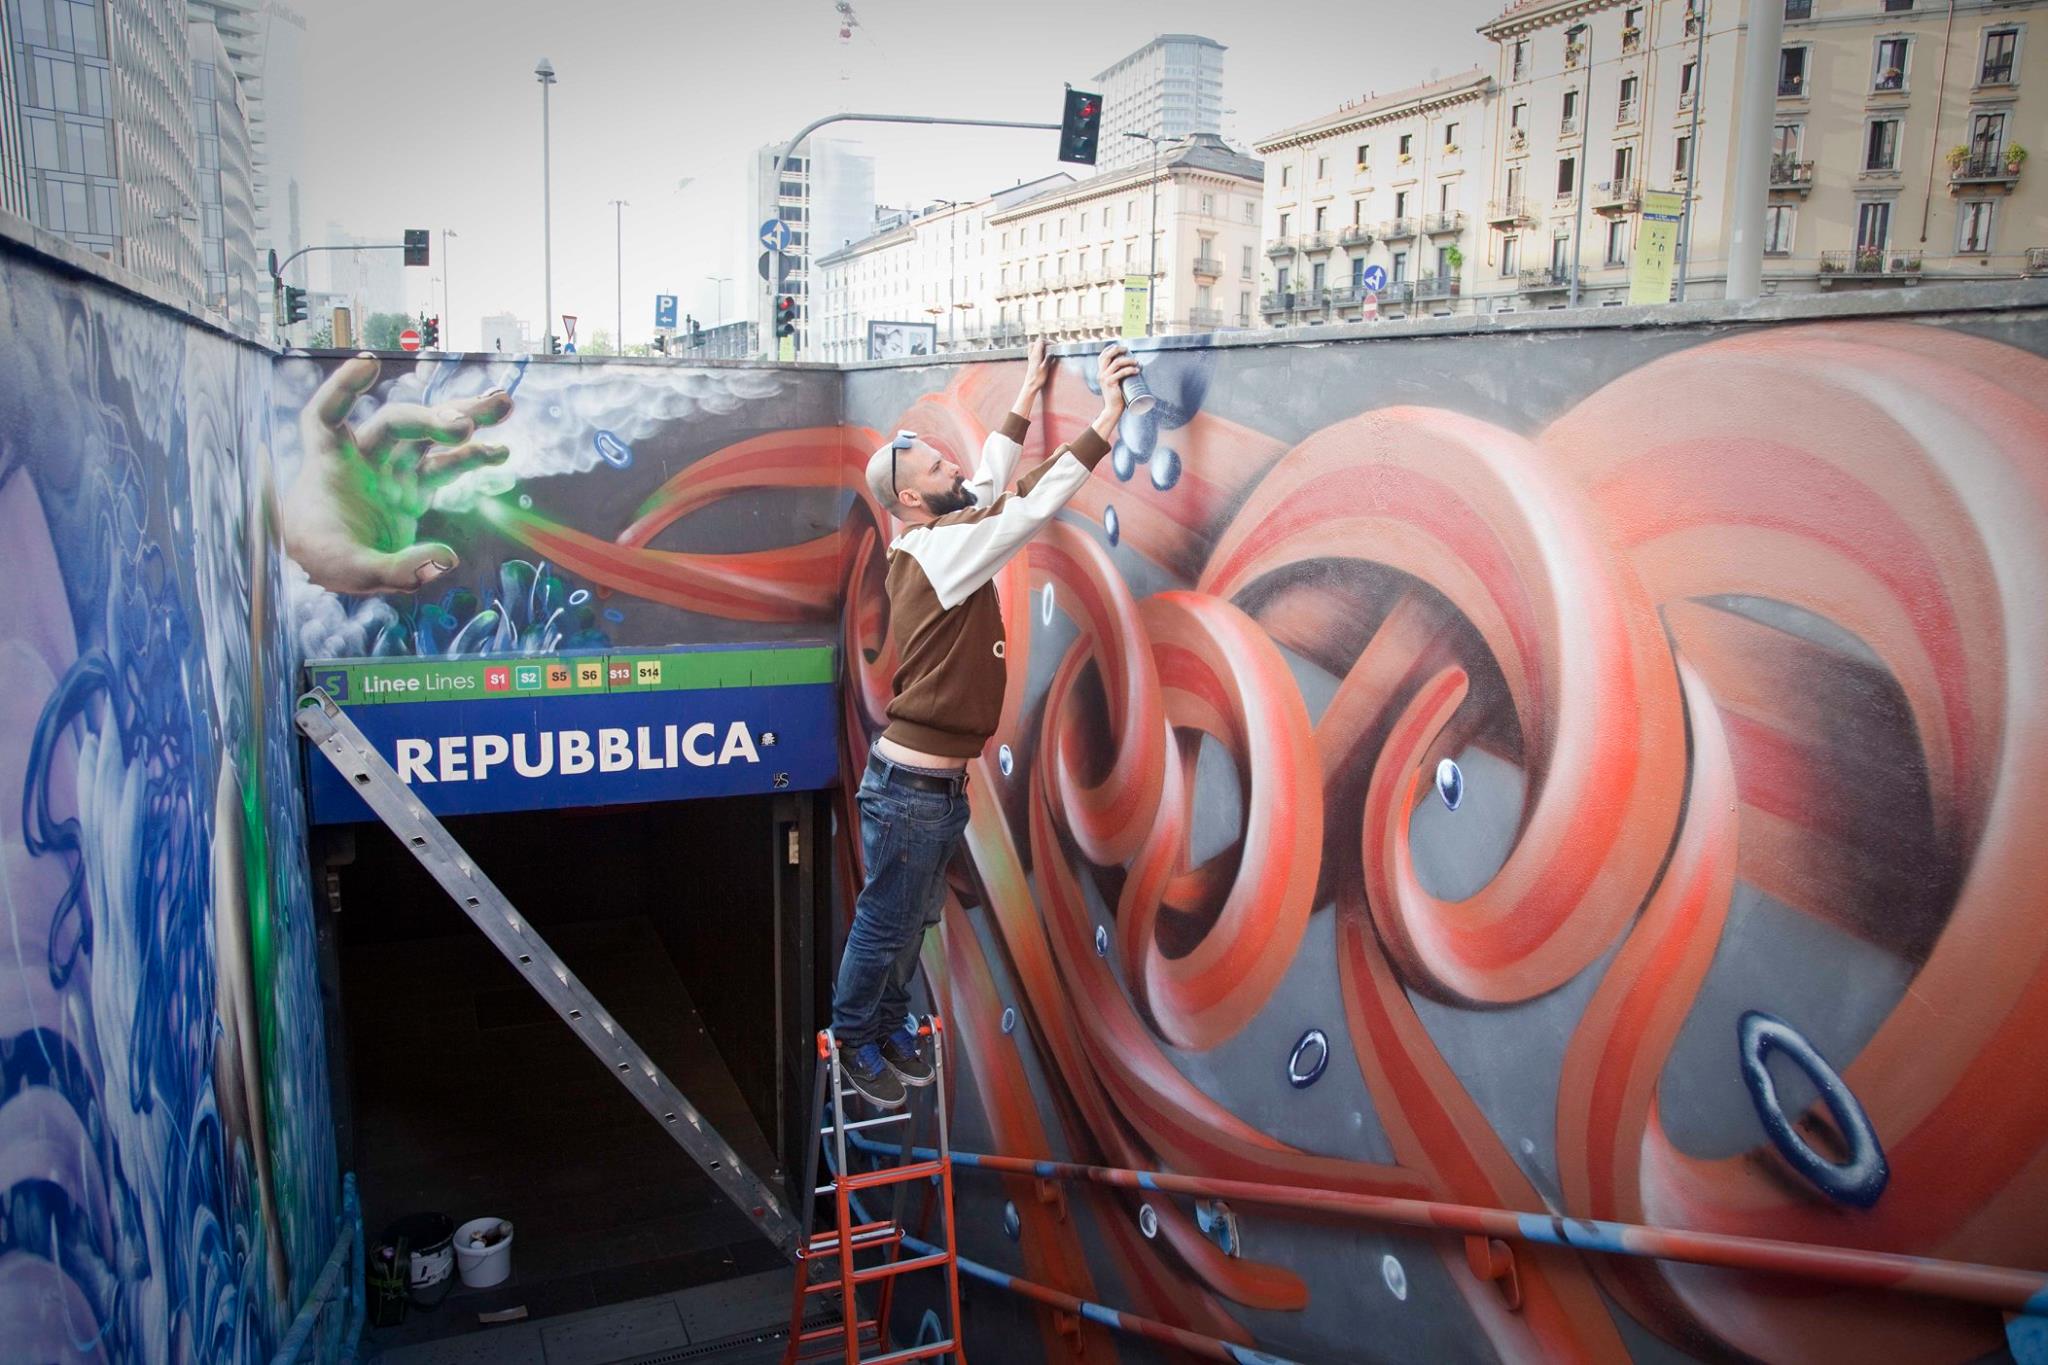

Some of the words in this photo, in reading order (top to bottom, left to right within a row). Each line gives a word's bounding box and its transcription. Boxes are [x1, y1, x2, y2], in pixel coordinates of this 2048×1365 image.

[661, 297, 672, 312] P
[364, 675, 420, 693] Linee
[426, 673, 475, 690] Lines
[490, 674, 506, 685] S1
[521, 672, 537, 683] S2
[551, 671, 567, 682] S5
[582, 670, 597, 681] S6
[609, 668, 631, 679] S13
[639, 667, 659, 678] S14
[396, 721, 761, 784] REPUBBLICA
